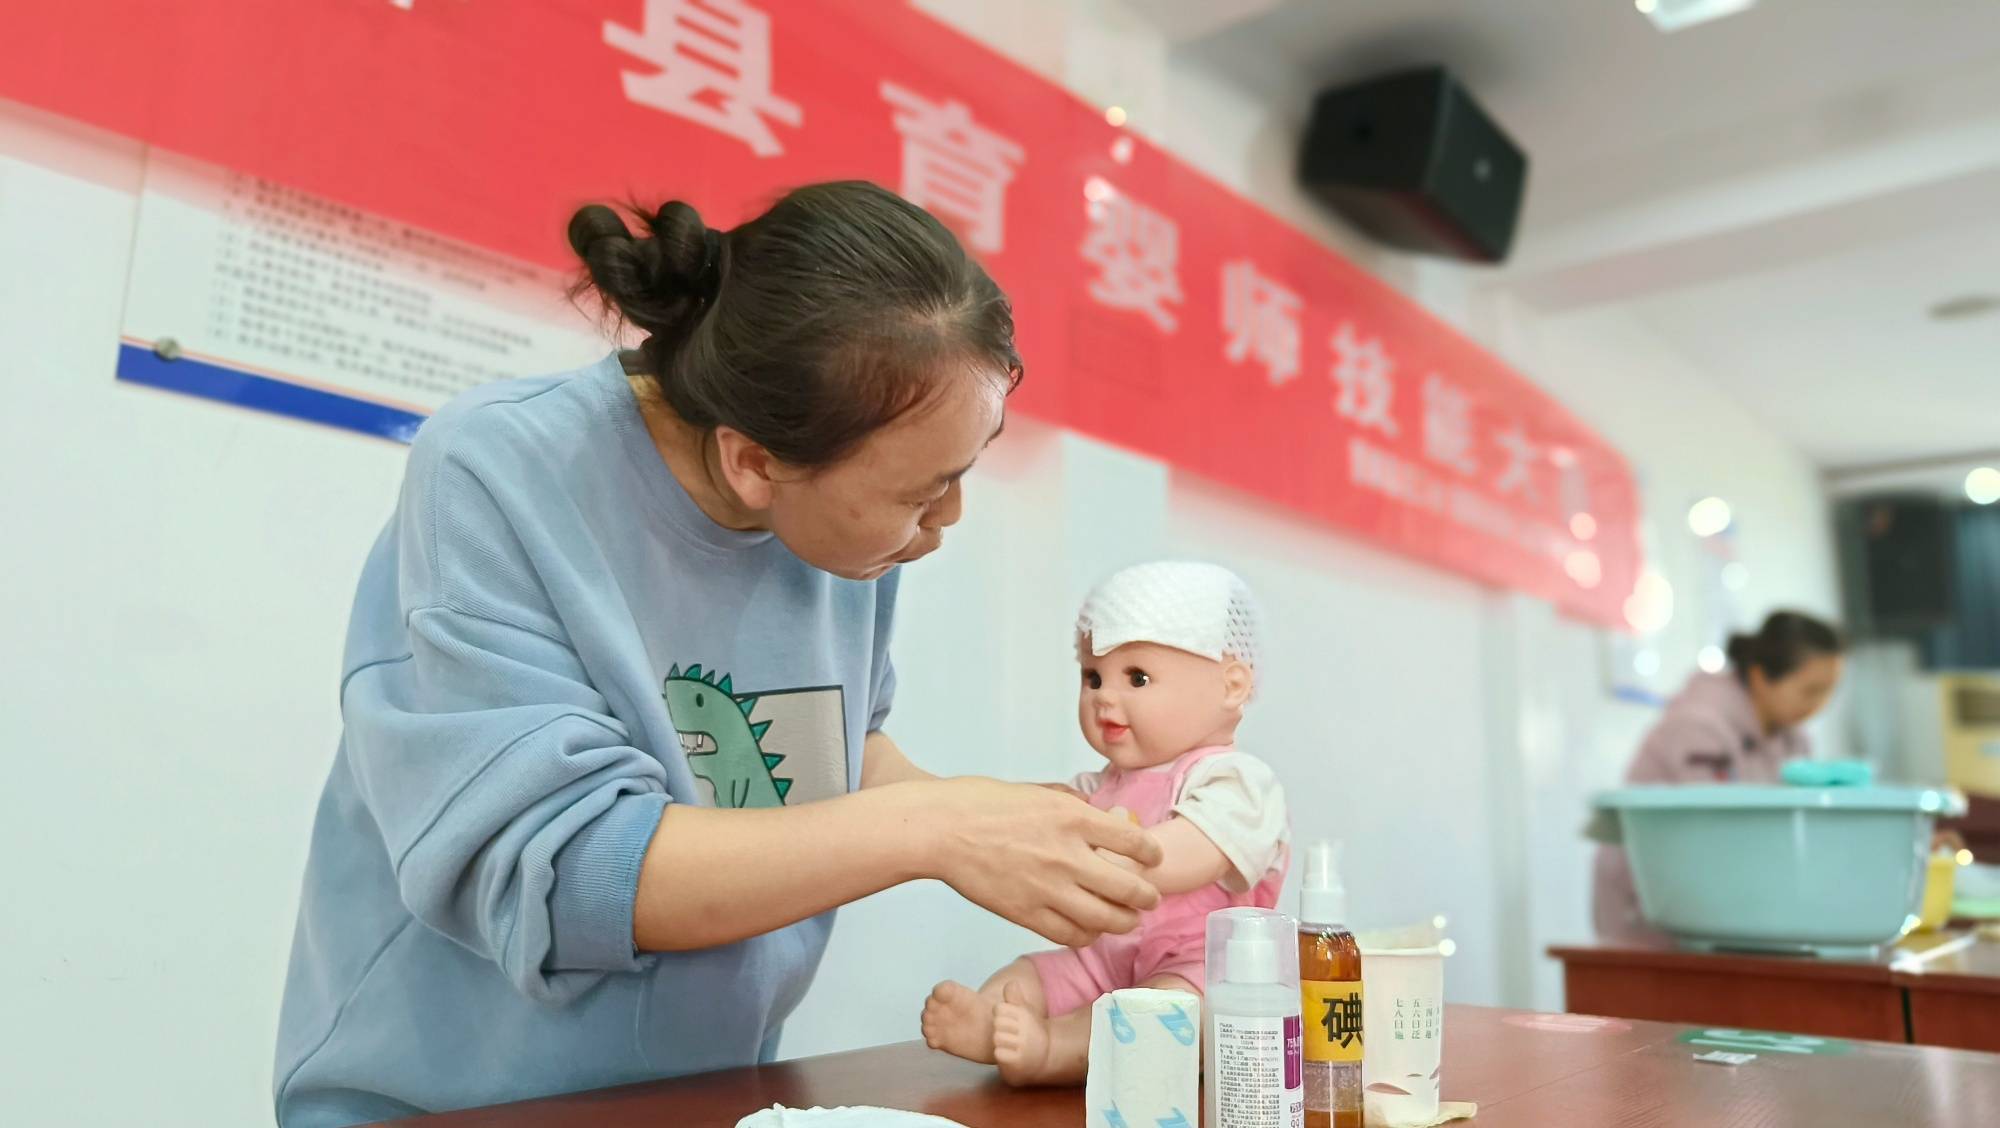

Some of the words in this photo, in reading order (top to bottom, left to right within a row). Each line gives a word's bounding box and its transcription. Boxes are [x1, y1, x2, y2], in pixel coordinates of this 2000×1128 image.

[390, 0, 1594, 534] 县育婴师技能大
[1321, 992, 1363, 1048] 碘
